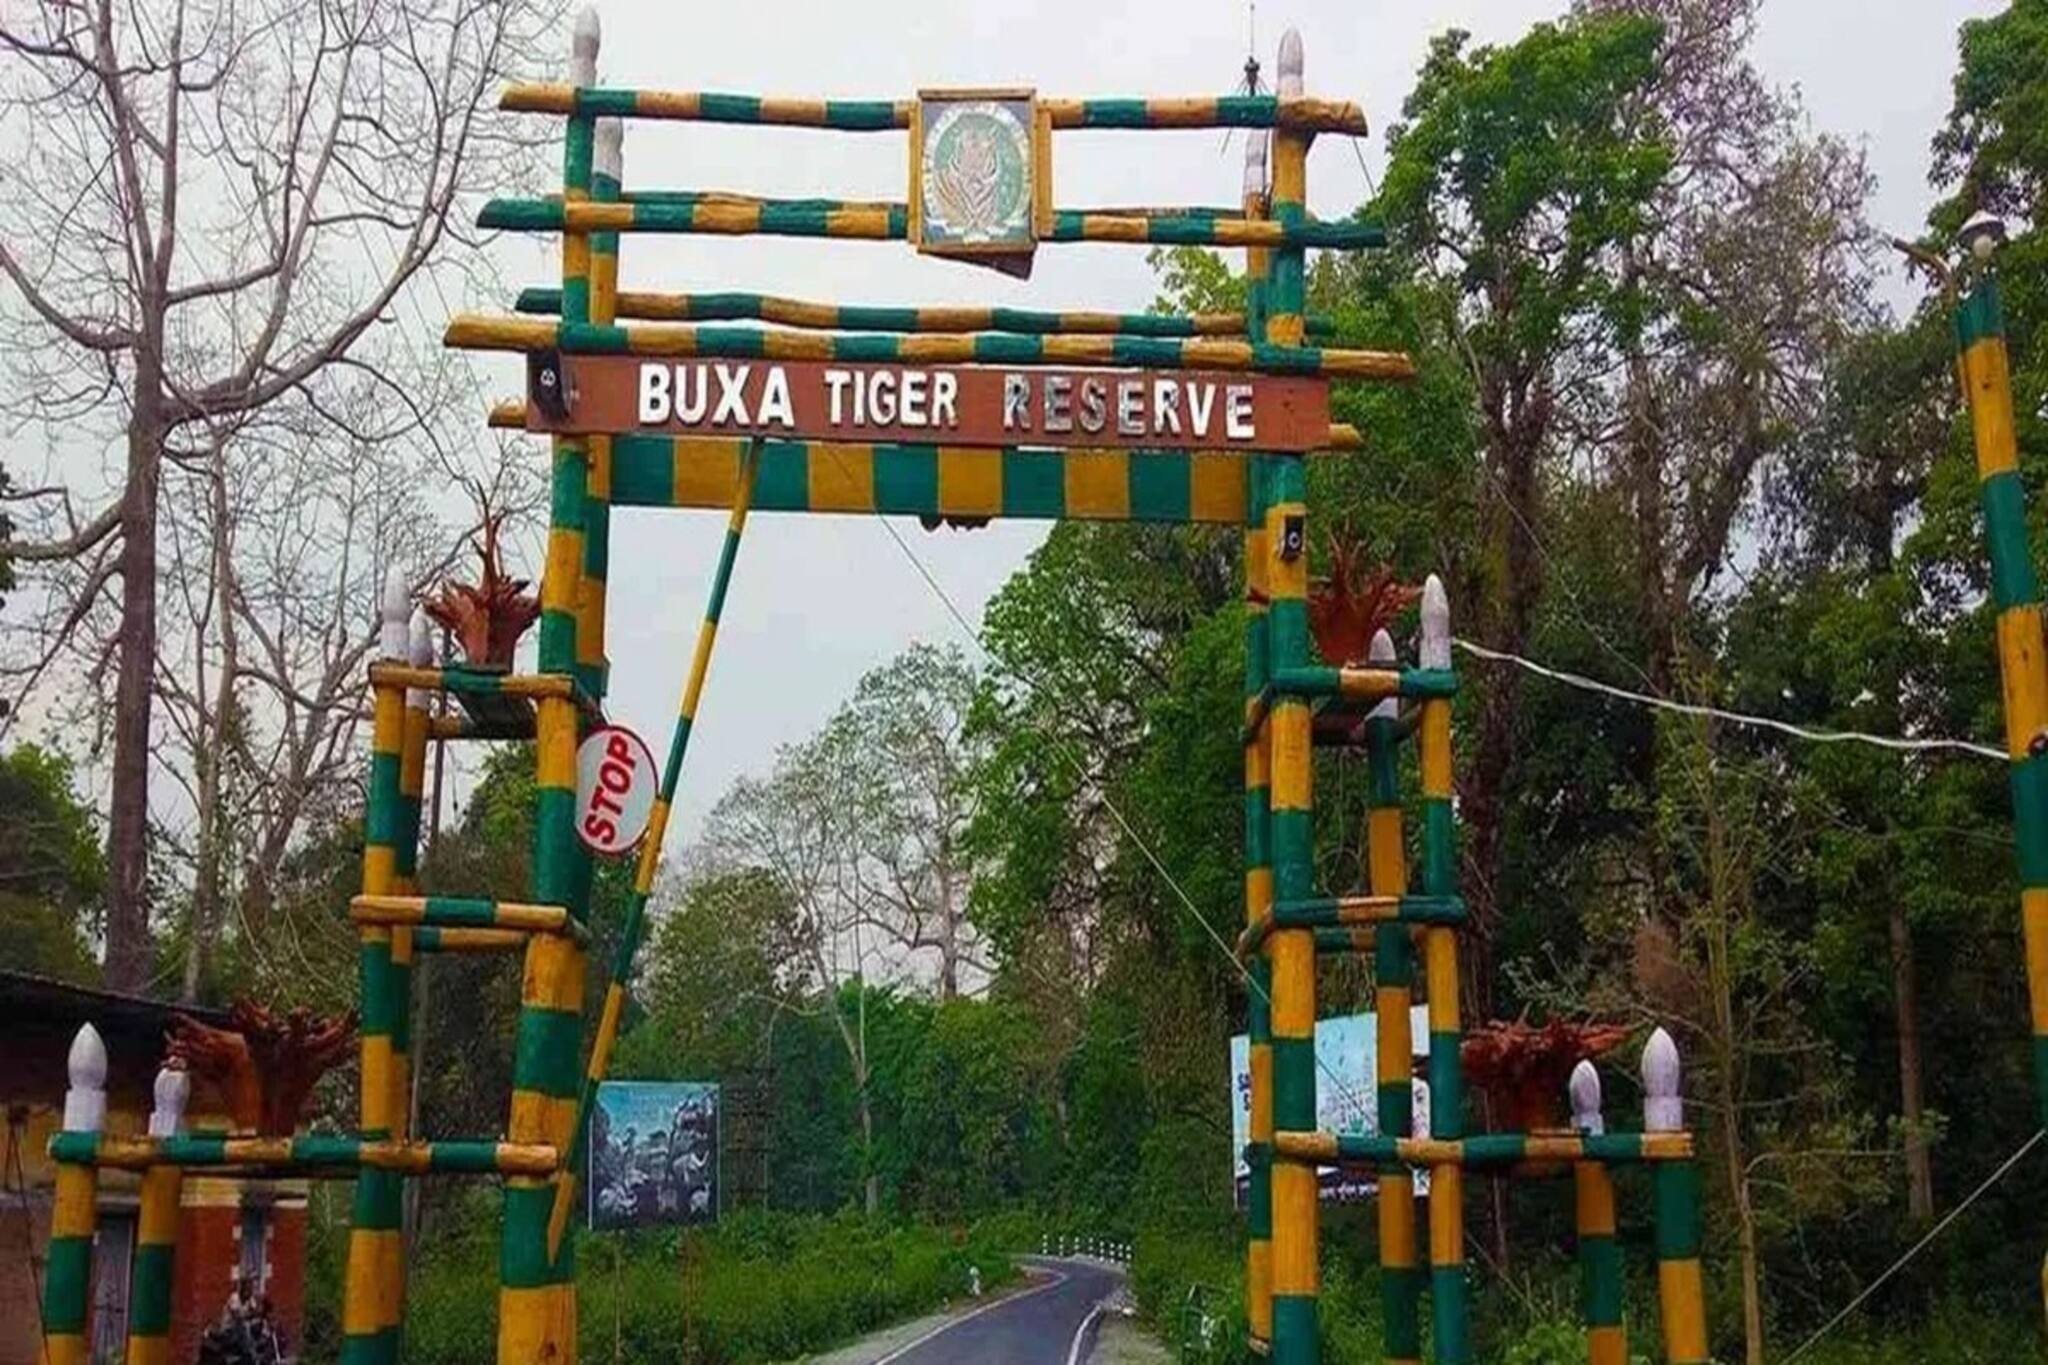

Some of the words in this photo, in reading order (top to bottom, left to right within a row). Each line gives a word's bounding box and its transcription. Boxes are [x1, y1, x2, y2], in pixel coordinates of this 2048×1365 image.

[638, 363, 795, 428] BUXA
[824, 369, 959, 427] TIGER
[1003, 373, 1256, 440] RESERVE
[584, 734, 636, 845] STOP
